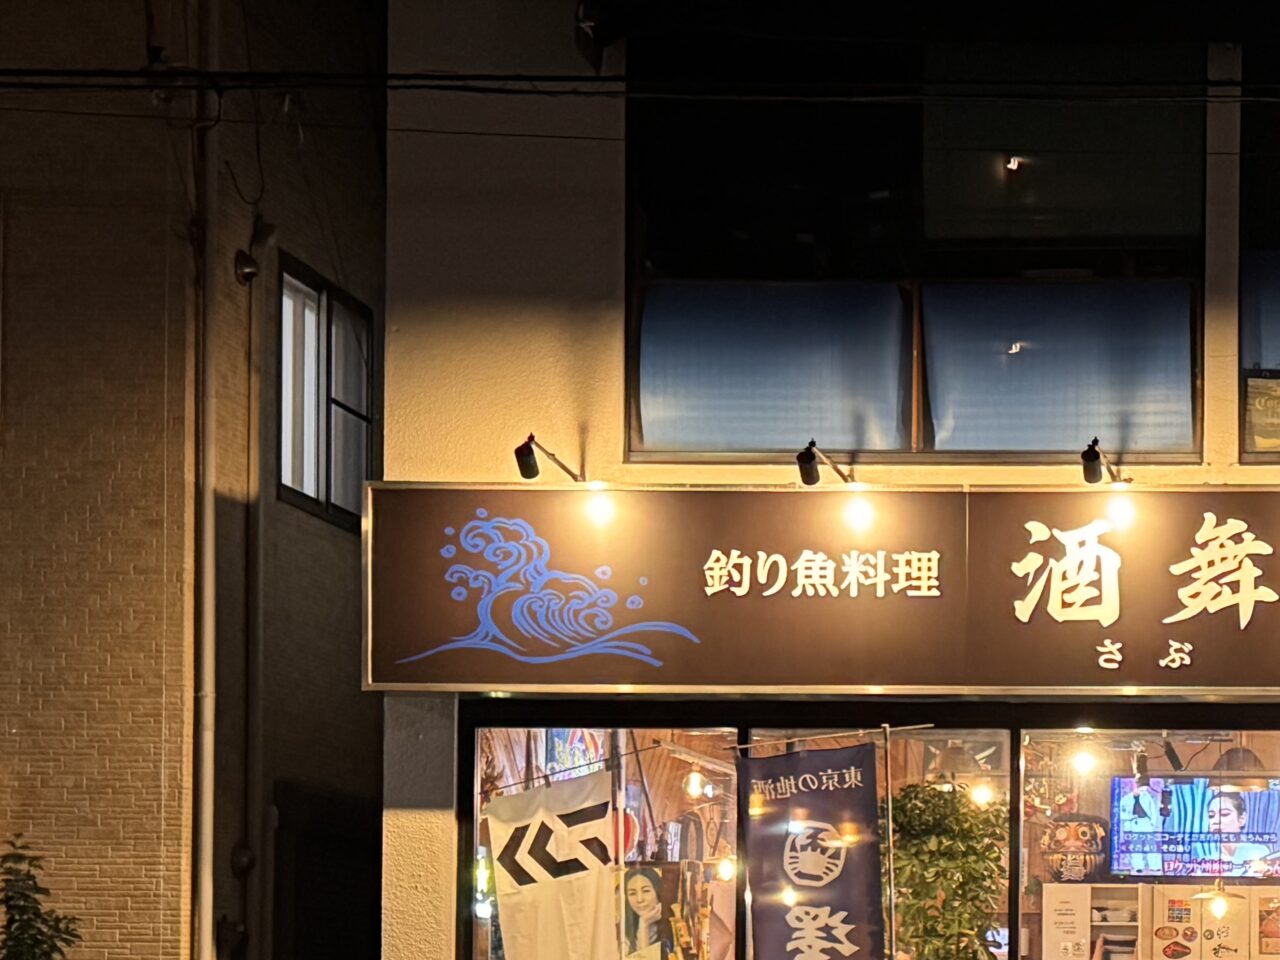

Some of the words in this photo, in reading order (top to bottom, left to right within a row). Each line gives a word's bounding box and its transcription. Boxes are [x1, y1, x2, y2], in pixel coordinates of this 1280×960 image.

[703, 549, 941, 598] 釣り魚料理
[1010, 512, 1280, 629] 酒舞
[1096, 639, 1192, 669] さぶ
